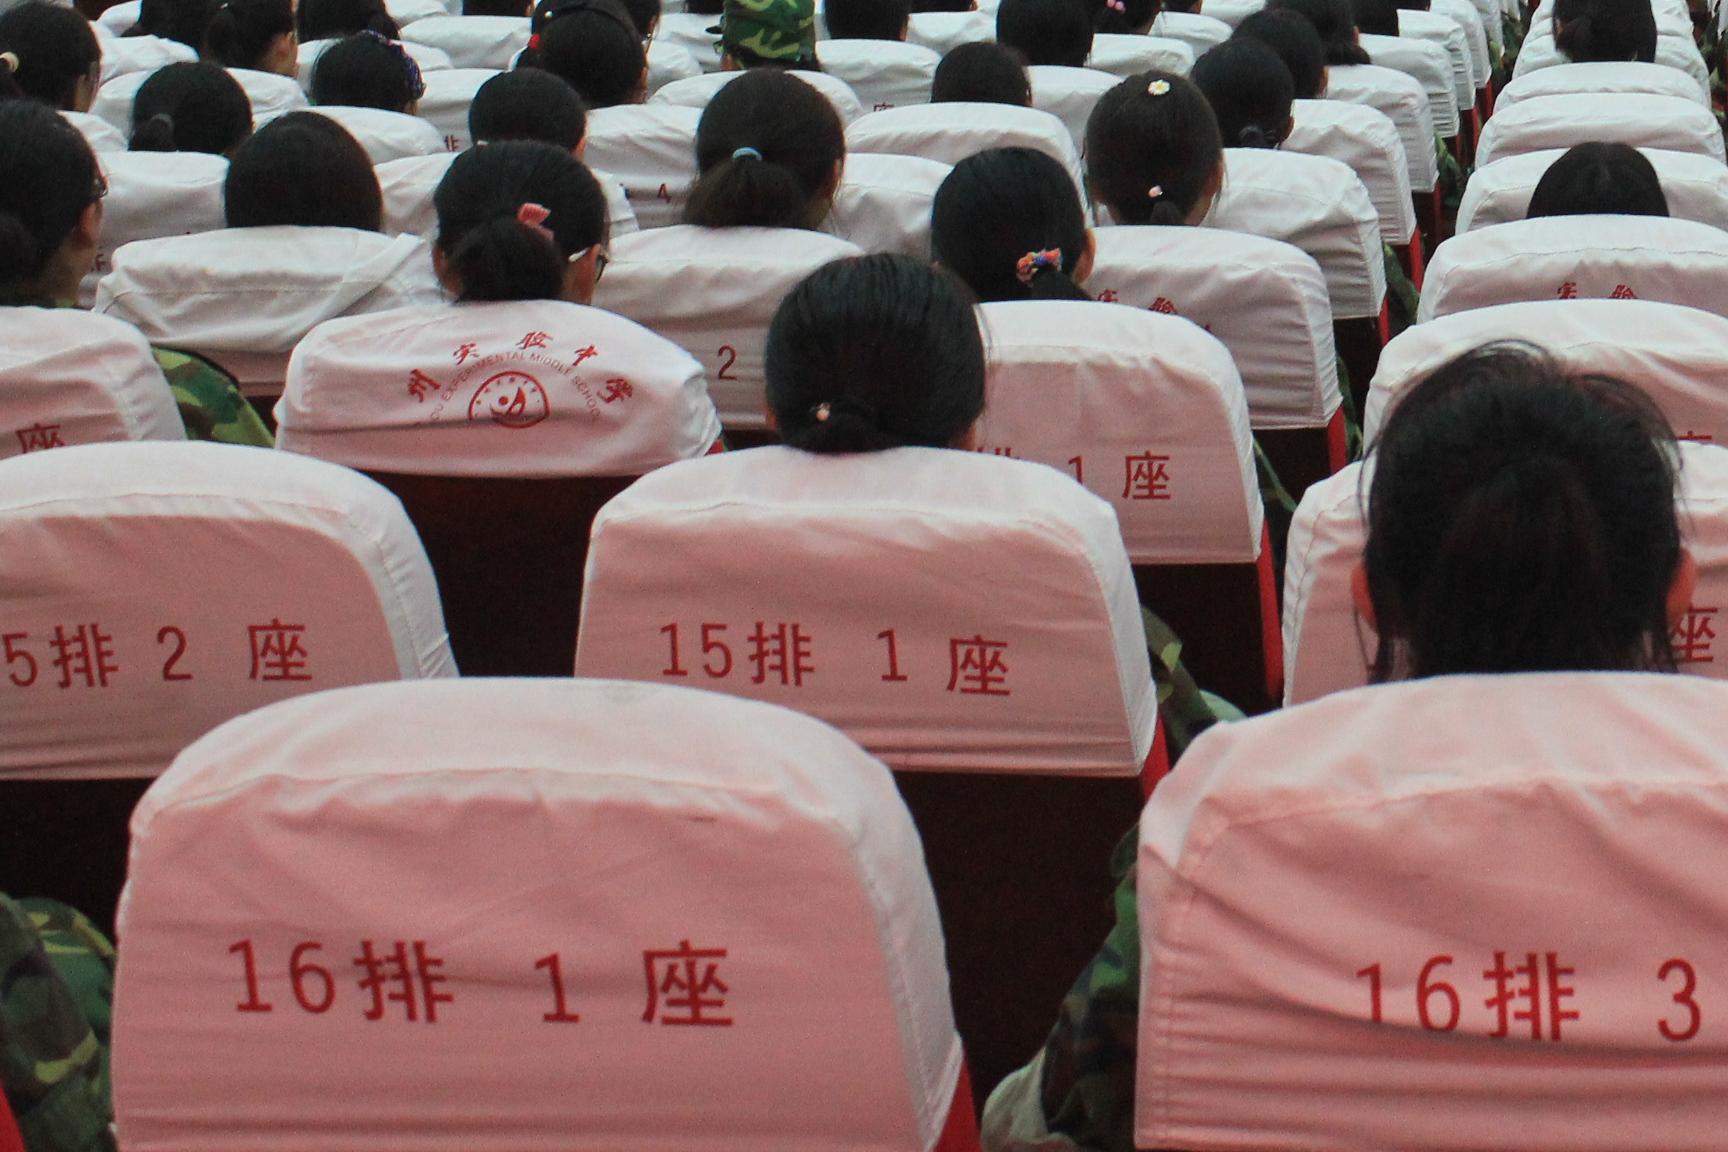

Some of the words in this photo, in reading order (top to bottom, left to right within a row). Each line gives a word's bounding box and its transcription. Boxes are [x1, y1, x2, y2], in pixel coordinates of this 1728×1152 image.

[529, 352, 571, 379] MIDDLE
[660, 620, 1011, 697] 15排1座
[227, 938, 735, 1028] 16排1座
